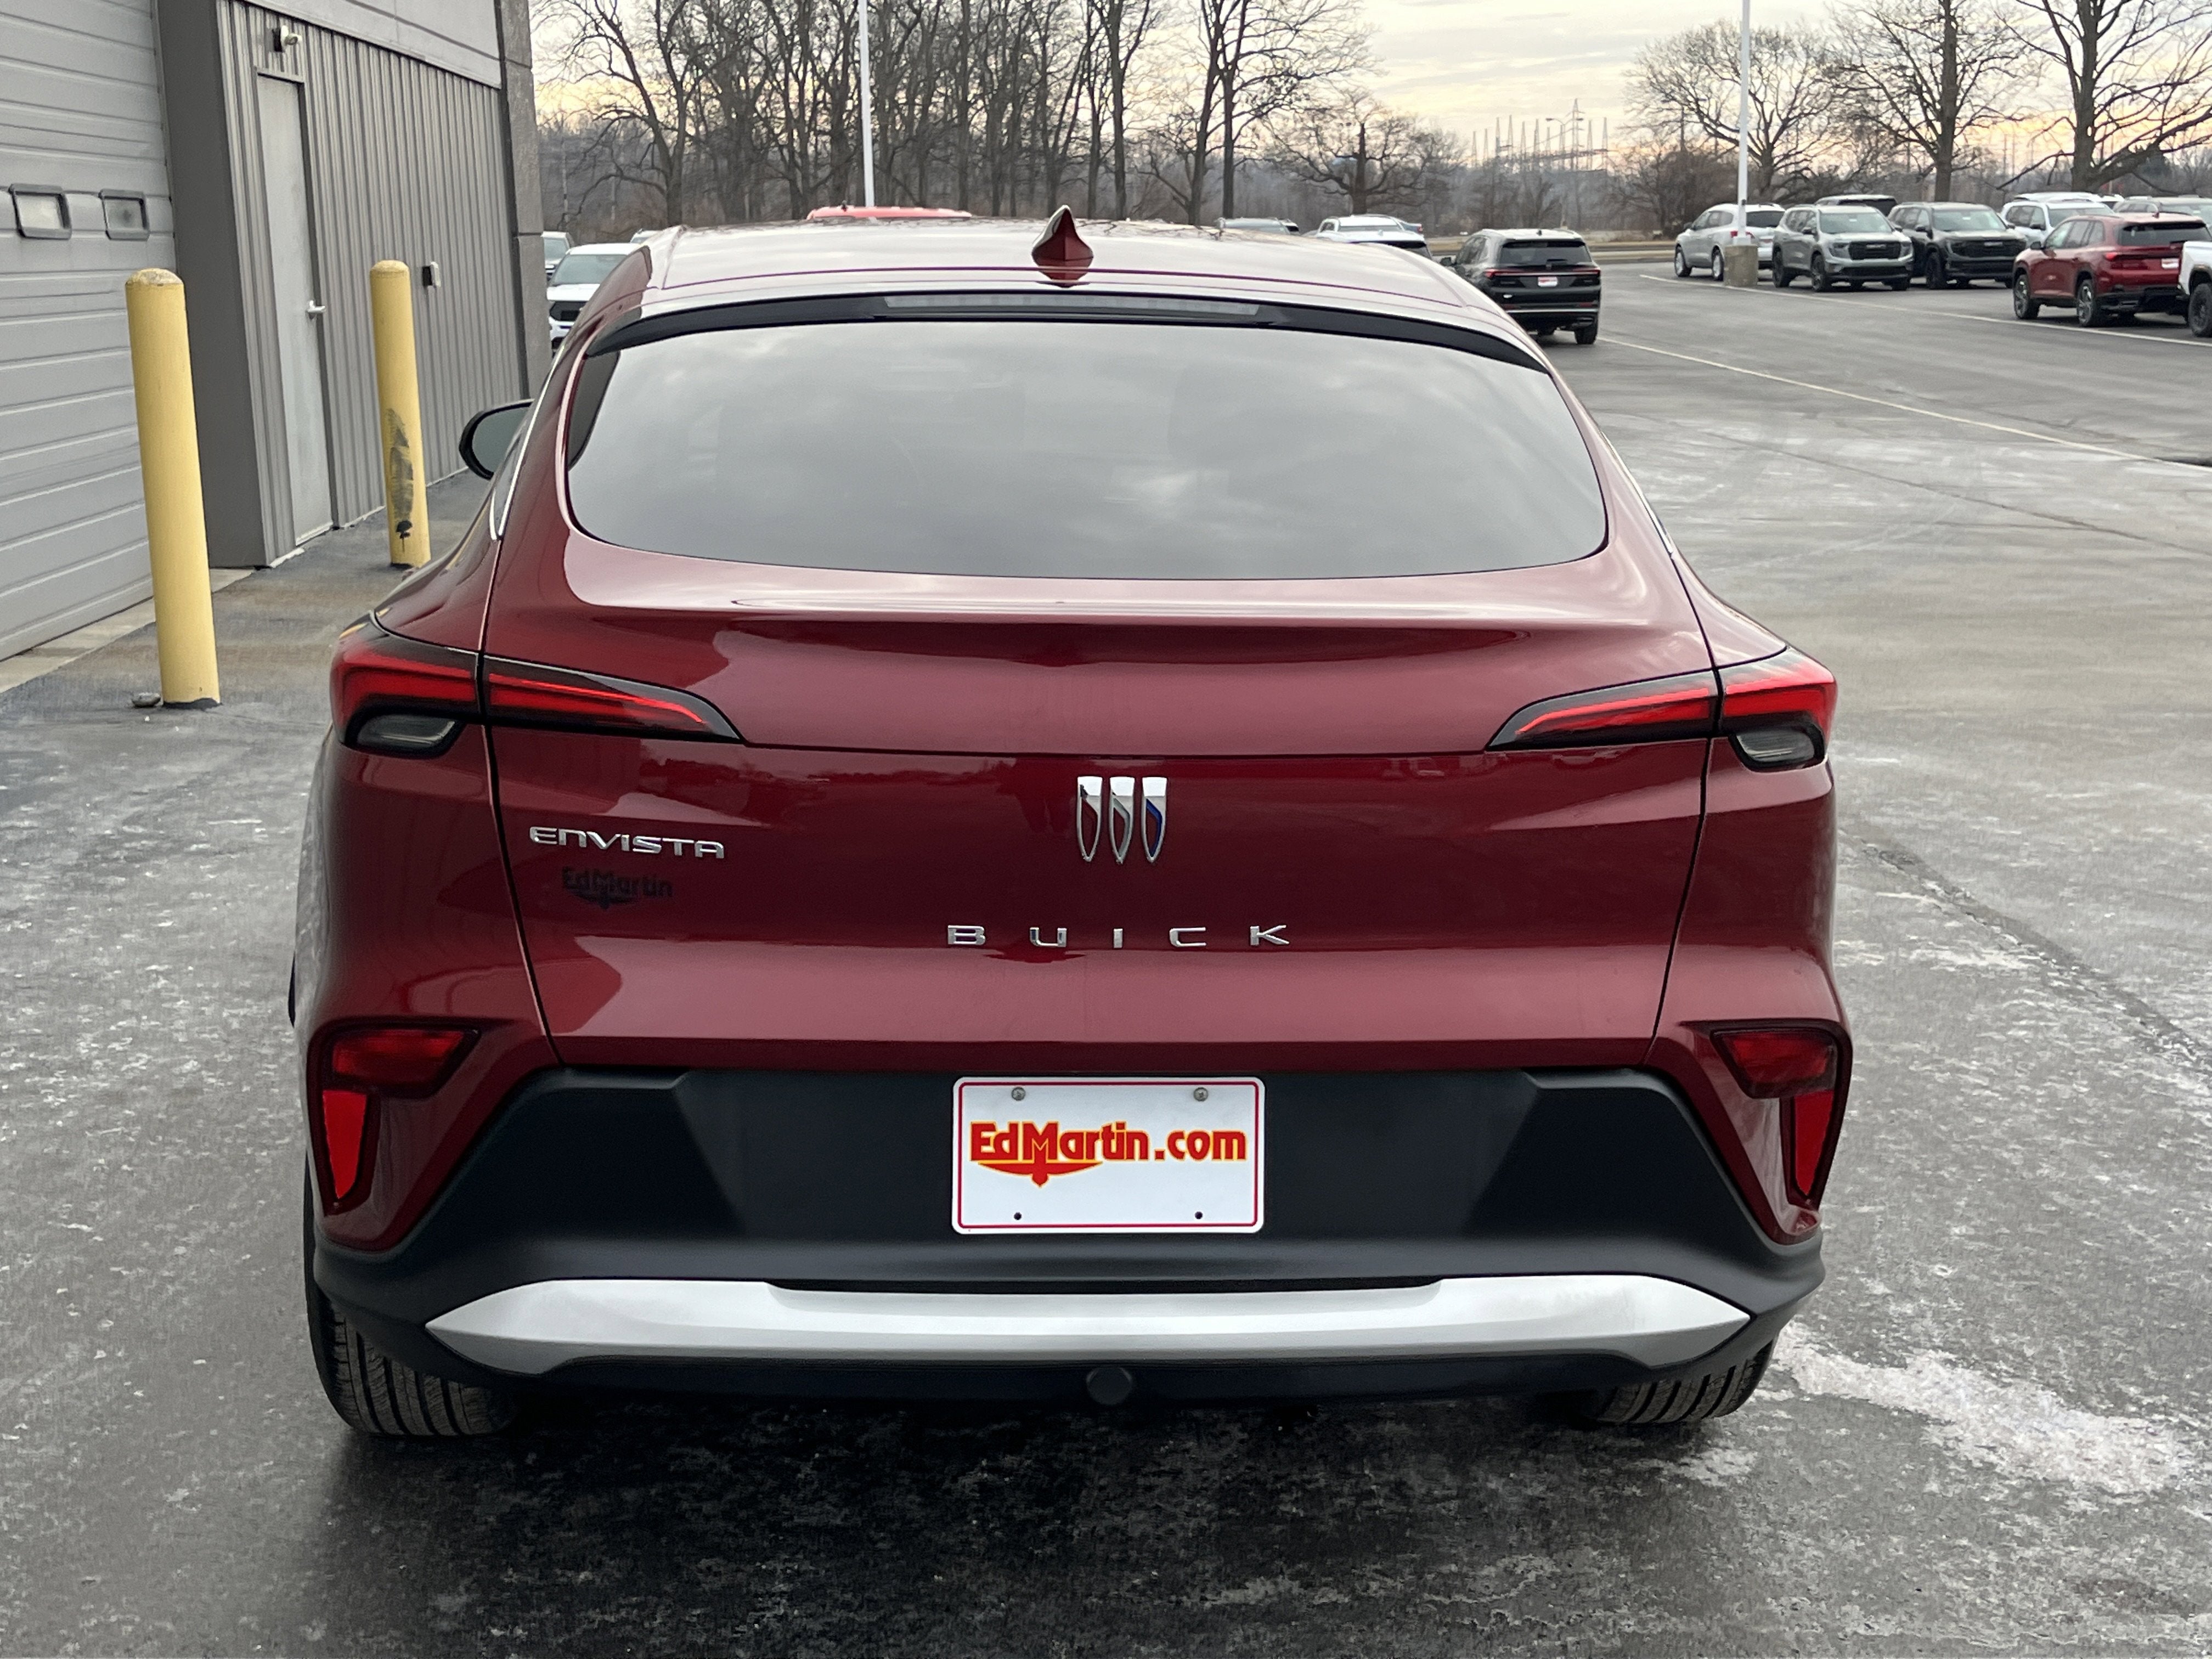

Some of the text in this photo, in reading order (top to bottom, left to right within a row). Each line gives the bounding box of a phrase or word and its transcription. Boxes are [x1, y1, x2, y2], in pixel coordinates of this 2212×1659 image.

[529, 826, 725, 859] ENVISTA
[562, 866, 673, 899] EdMartin
[947, 925, 1289, 949] BUICK
[969, 1120, 1247, 1161] EdMartin.com
